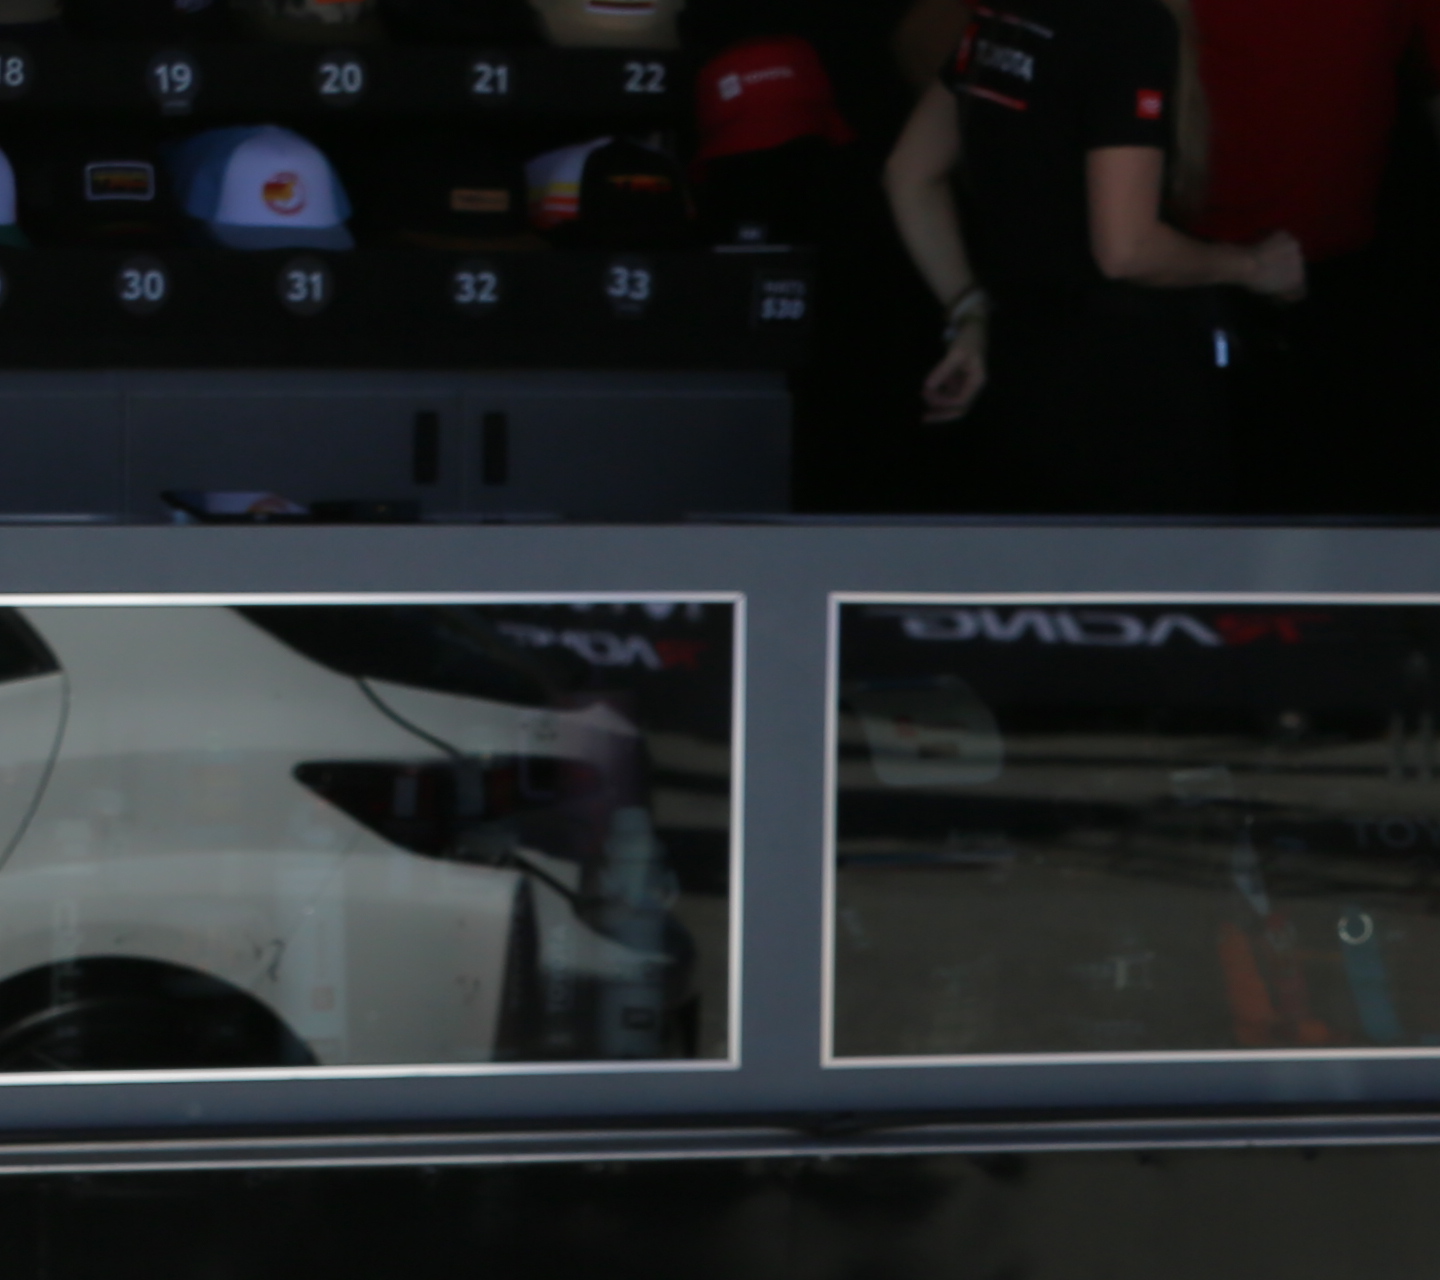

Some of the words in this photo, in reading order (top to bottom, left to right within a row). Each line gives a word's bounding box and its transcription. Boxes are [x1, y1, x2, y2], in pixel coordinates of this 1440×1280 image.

[0, 55, 25, 87] 8
[153, 62, 193, 93] 19
[319, 62, 363, 94] 20
[472, 62, 509, 94] 21
[623, 62, 667, 93] 22
[120, 268, 165, 302] 30
[285, 269, 325, 302] 31
[454, 271, 499, 303] 32
[606, 265, 652, 301] 33
